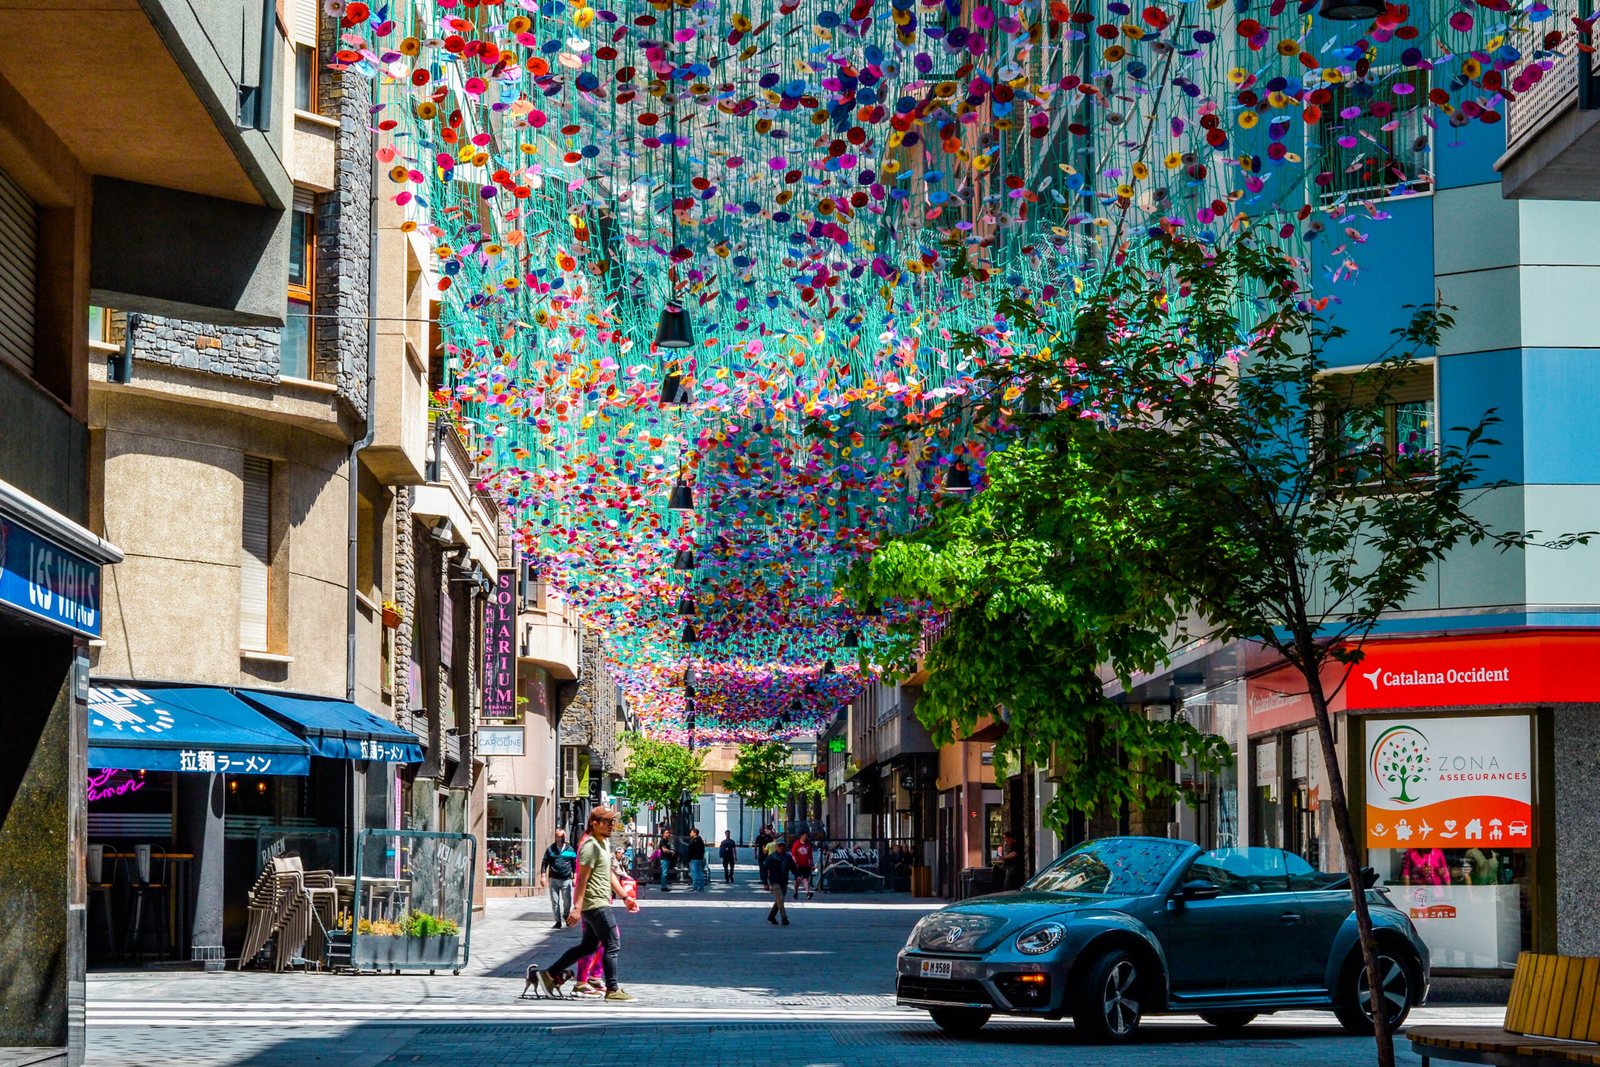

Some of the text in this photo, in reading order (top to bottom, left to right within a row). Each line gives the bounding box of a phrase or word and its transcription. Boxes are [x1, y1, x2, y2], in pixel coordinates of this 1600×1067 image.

[29, 542, 95, 627] LES VALLS
[497, 575, 512, 703] SOLARIUM
[1383, 667, 1510, 687] Catalana Occident
[1438, 756, 1500, 771] ZONA
[1439, 772, 1528, 782] ASSEGURANCES
